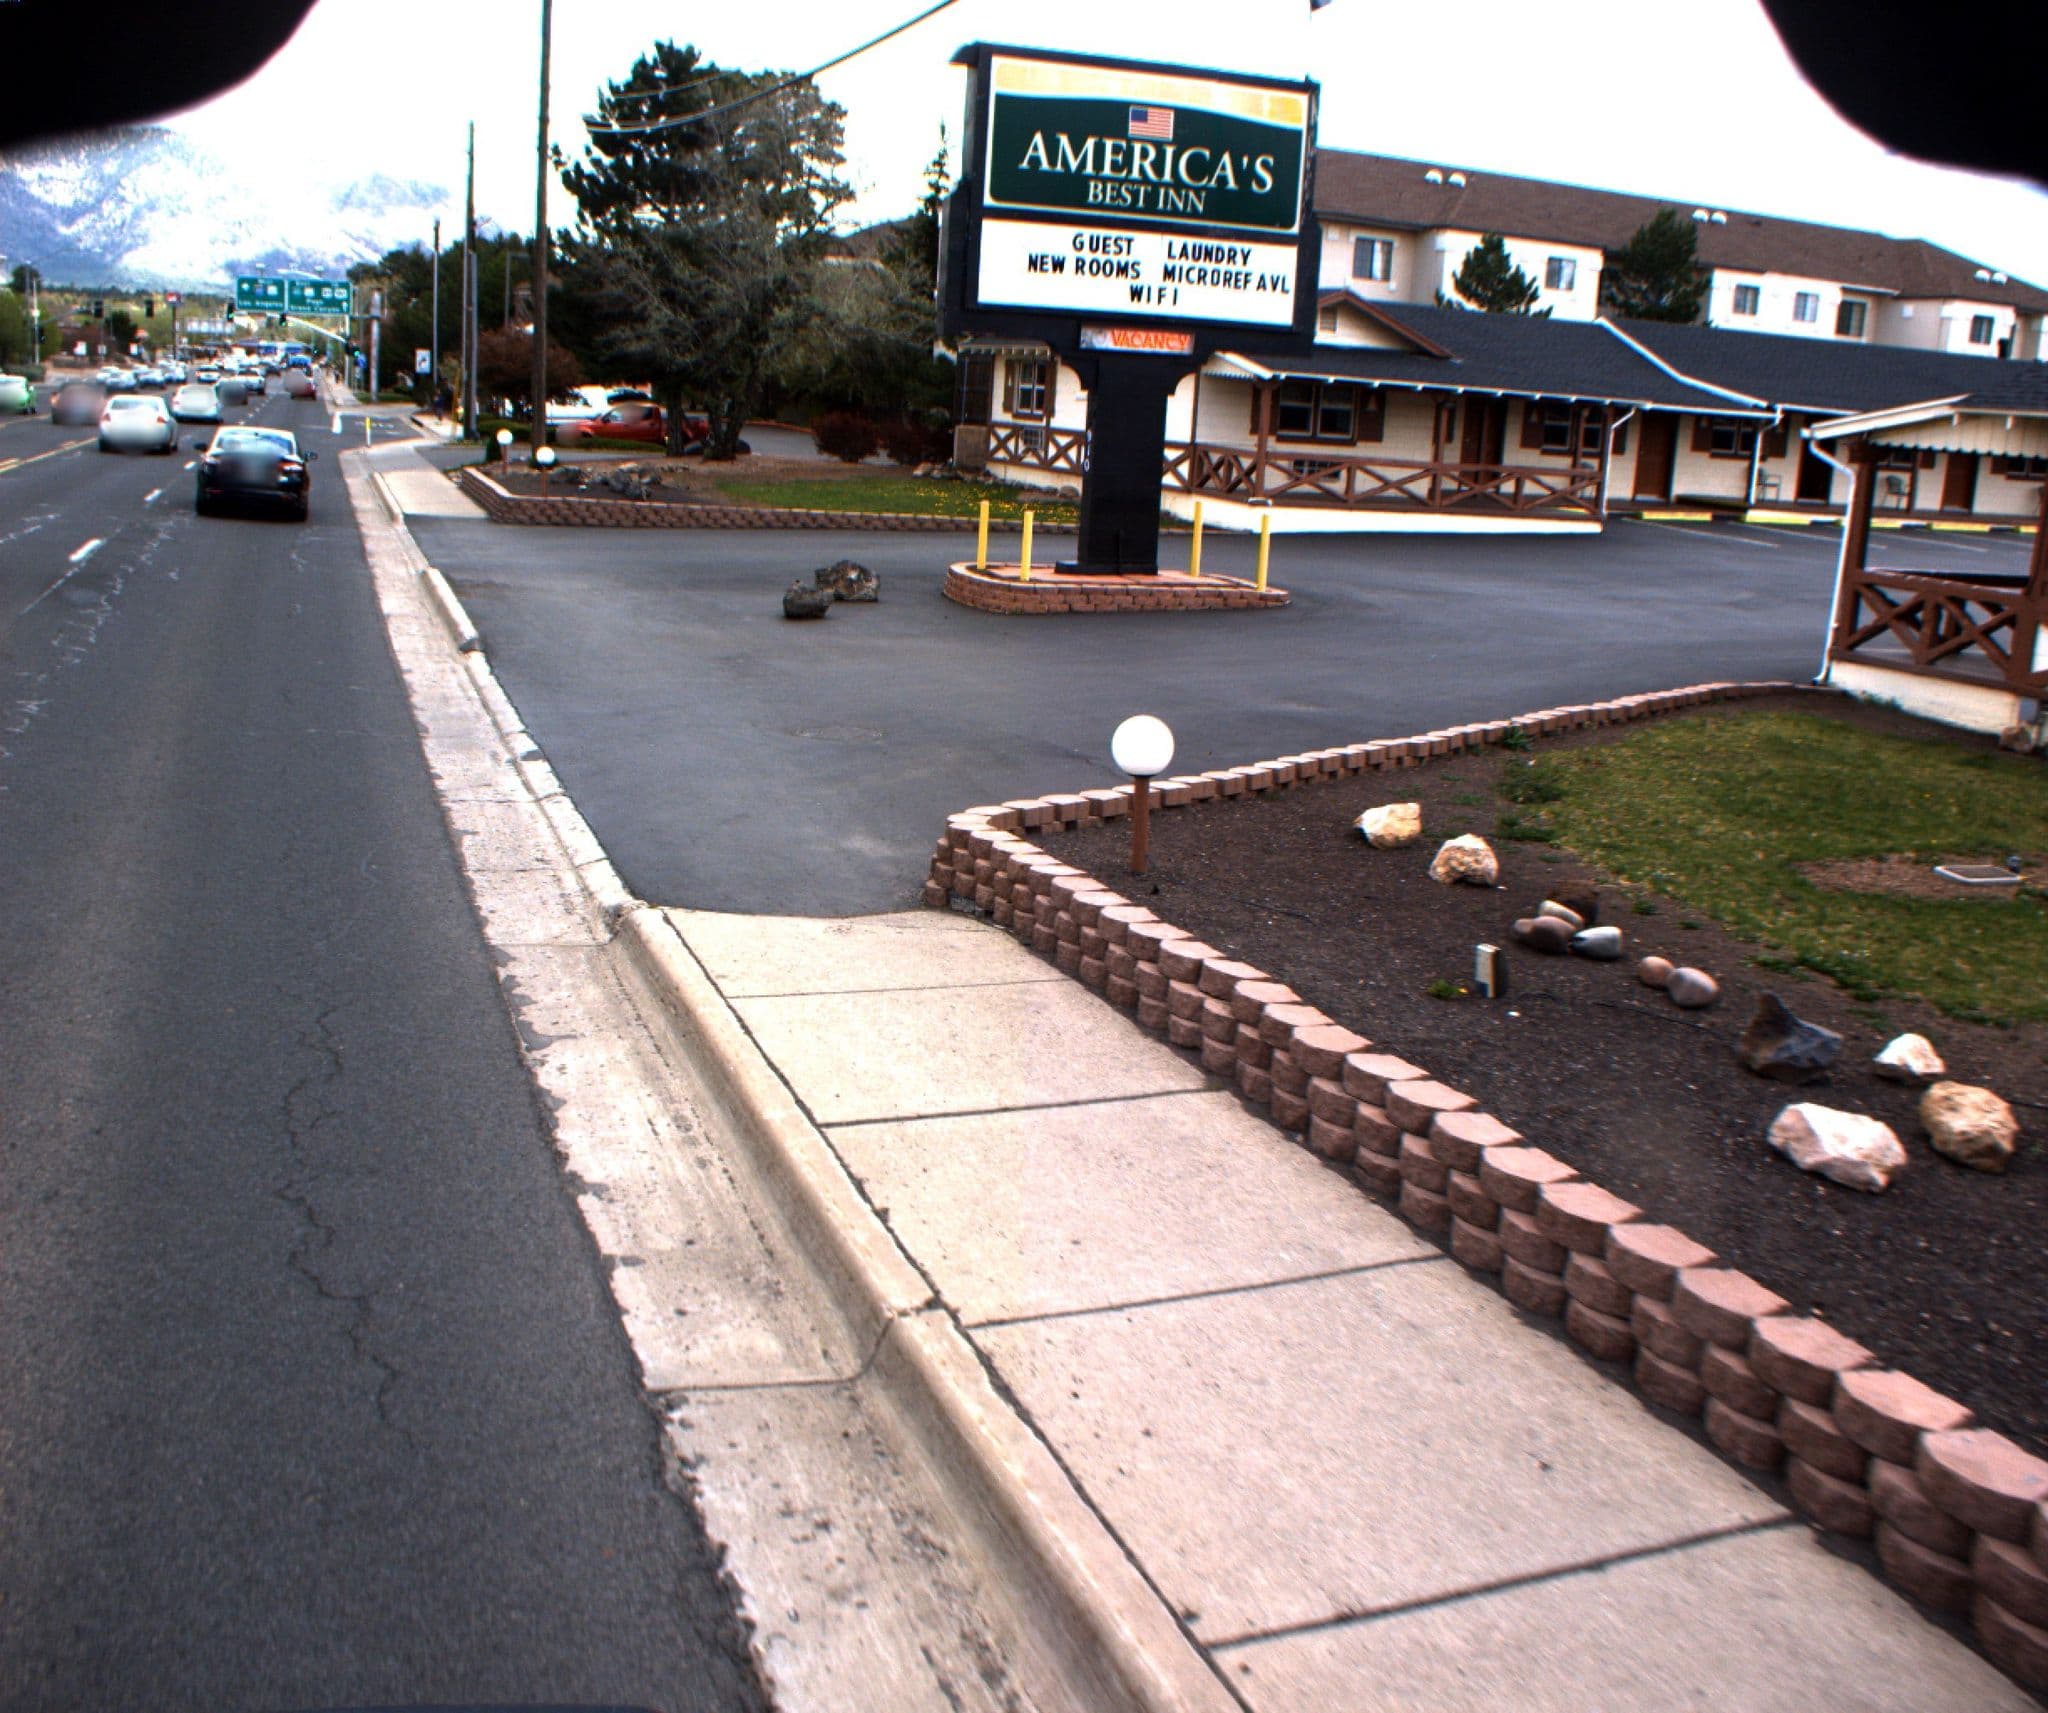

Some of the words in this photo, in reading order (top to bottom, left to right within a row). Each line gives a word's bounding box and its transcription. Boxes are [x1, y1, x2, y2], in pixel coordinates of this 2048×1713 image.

[1018, 130, 1274, 193] AMERICA'S
[1088, 180, 1151, 208] BEST
[1158, 187, 1207, 213] INN
[1072, 233, 1134, 256] GUEST
[1167, 240, 1251, 266] LAUNDRY
[1028, 253, 1066, 274] NEW
[1075, 257, 1141, 279] ROOMS
[1256, 272, 1290, 294] AVL
[1130, 285, 1178, 306] WIFI
[1111, 328, 1190, 350] VACANCY
